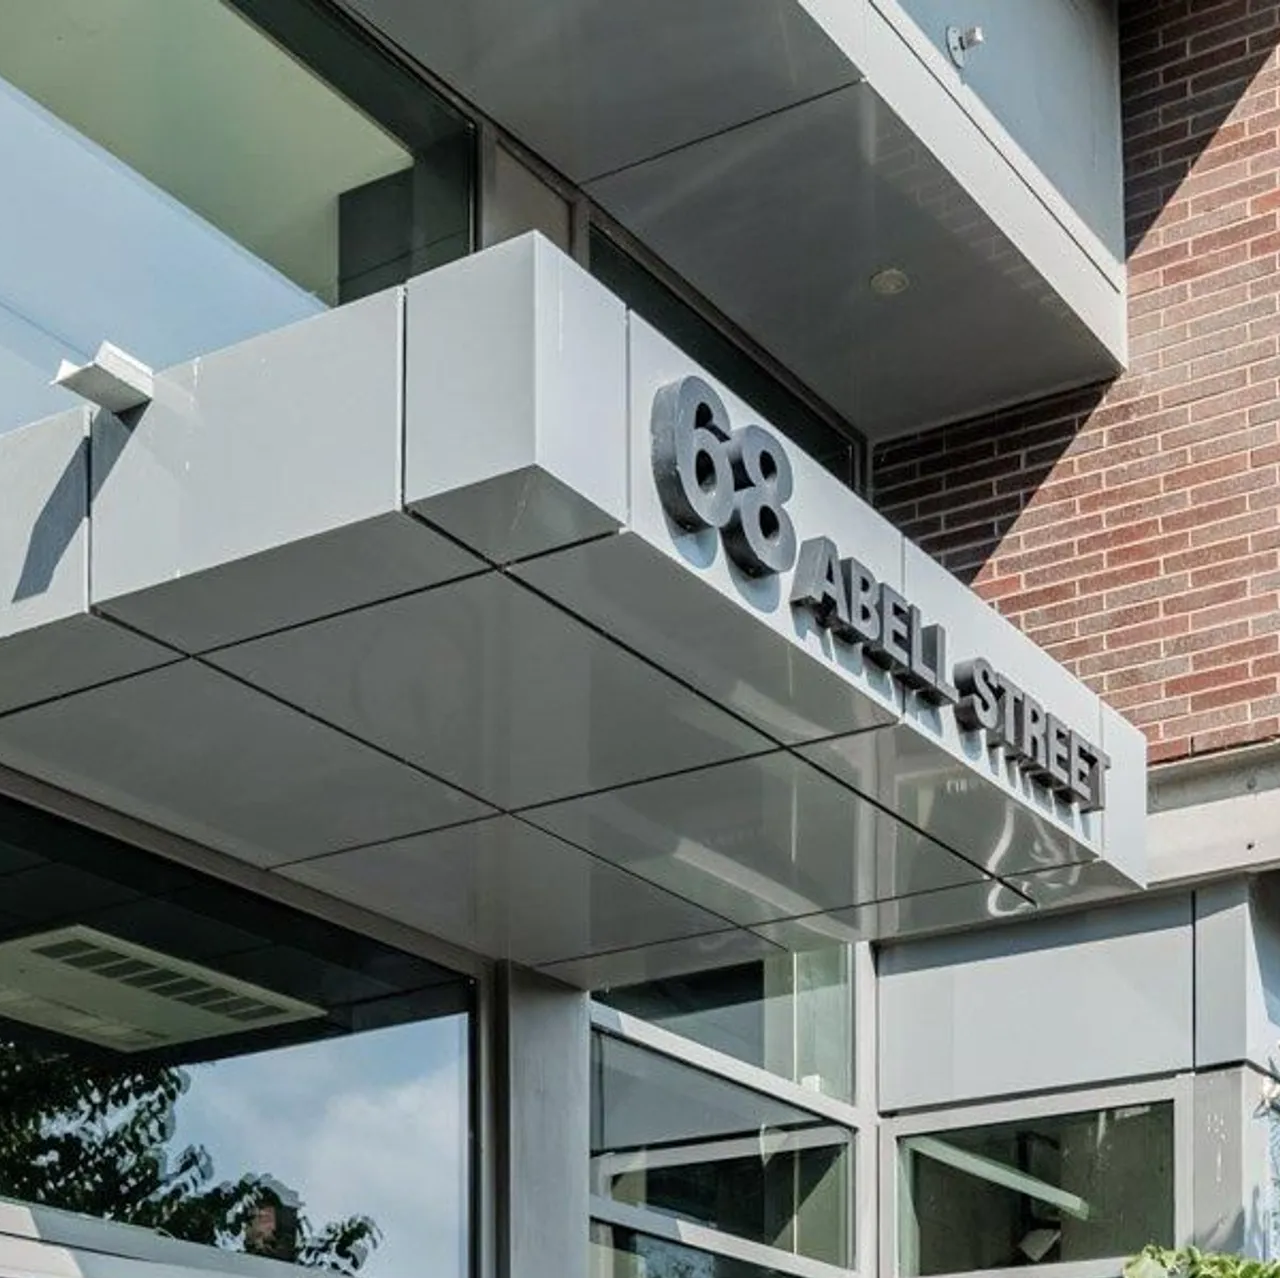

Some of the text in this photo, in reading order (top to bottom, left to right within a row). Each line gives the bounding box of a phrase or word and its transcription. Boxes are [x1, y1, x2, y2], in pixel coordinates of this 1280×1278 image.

[651, 375, 1111, 812] 68 ABELL STREET
